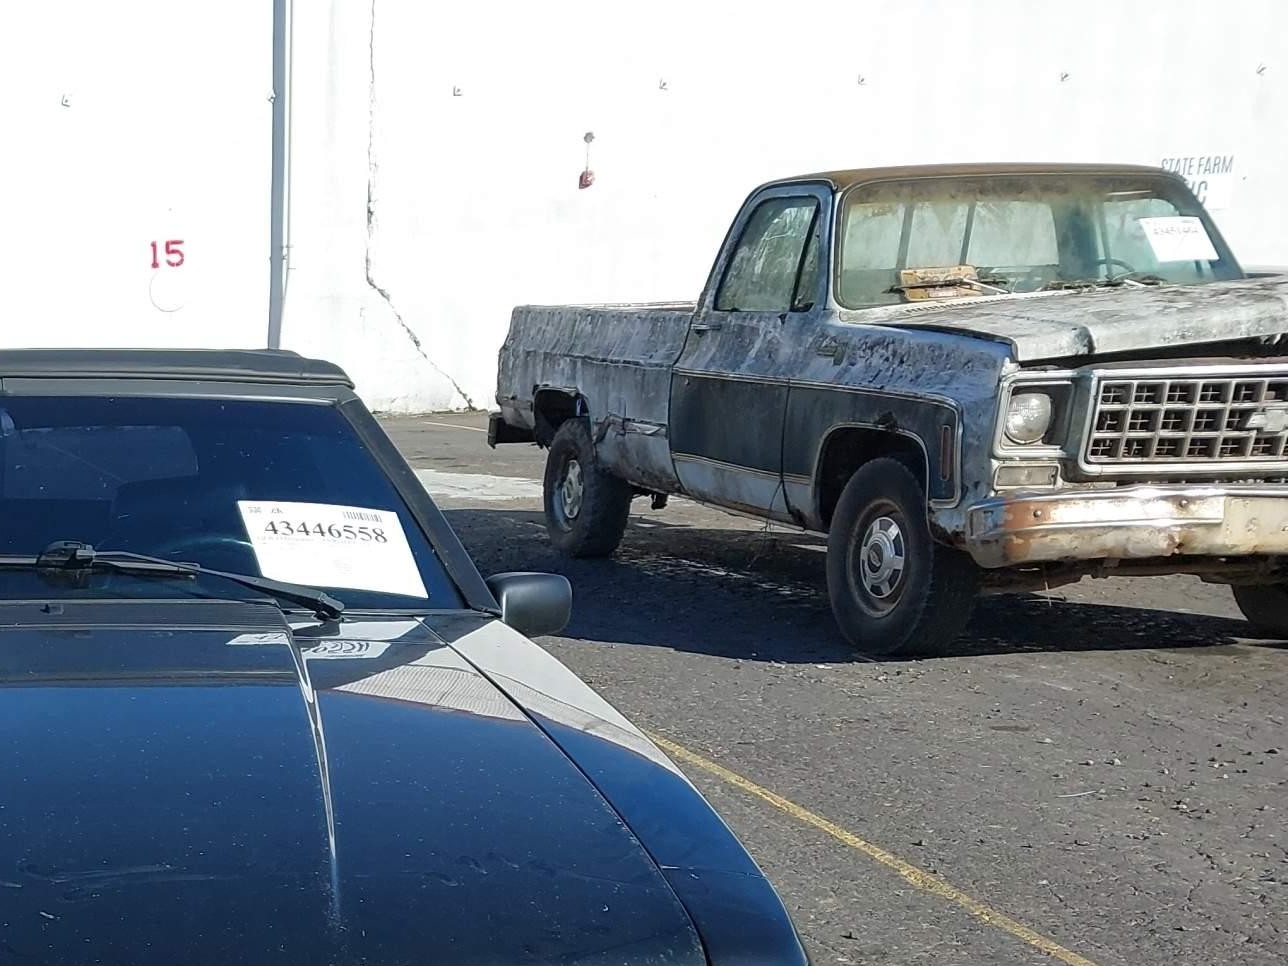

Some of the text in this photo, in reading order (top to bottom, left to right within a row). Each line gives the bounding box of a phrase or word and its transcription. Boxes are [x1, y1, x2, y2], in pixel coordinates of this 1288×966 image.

[1161, 155, 1234, 175] STATE FARM
[150, 240, 185, 269] 15
[264, 520, 388, 544] 43446558
